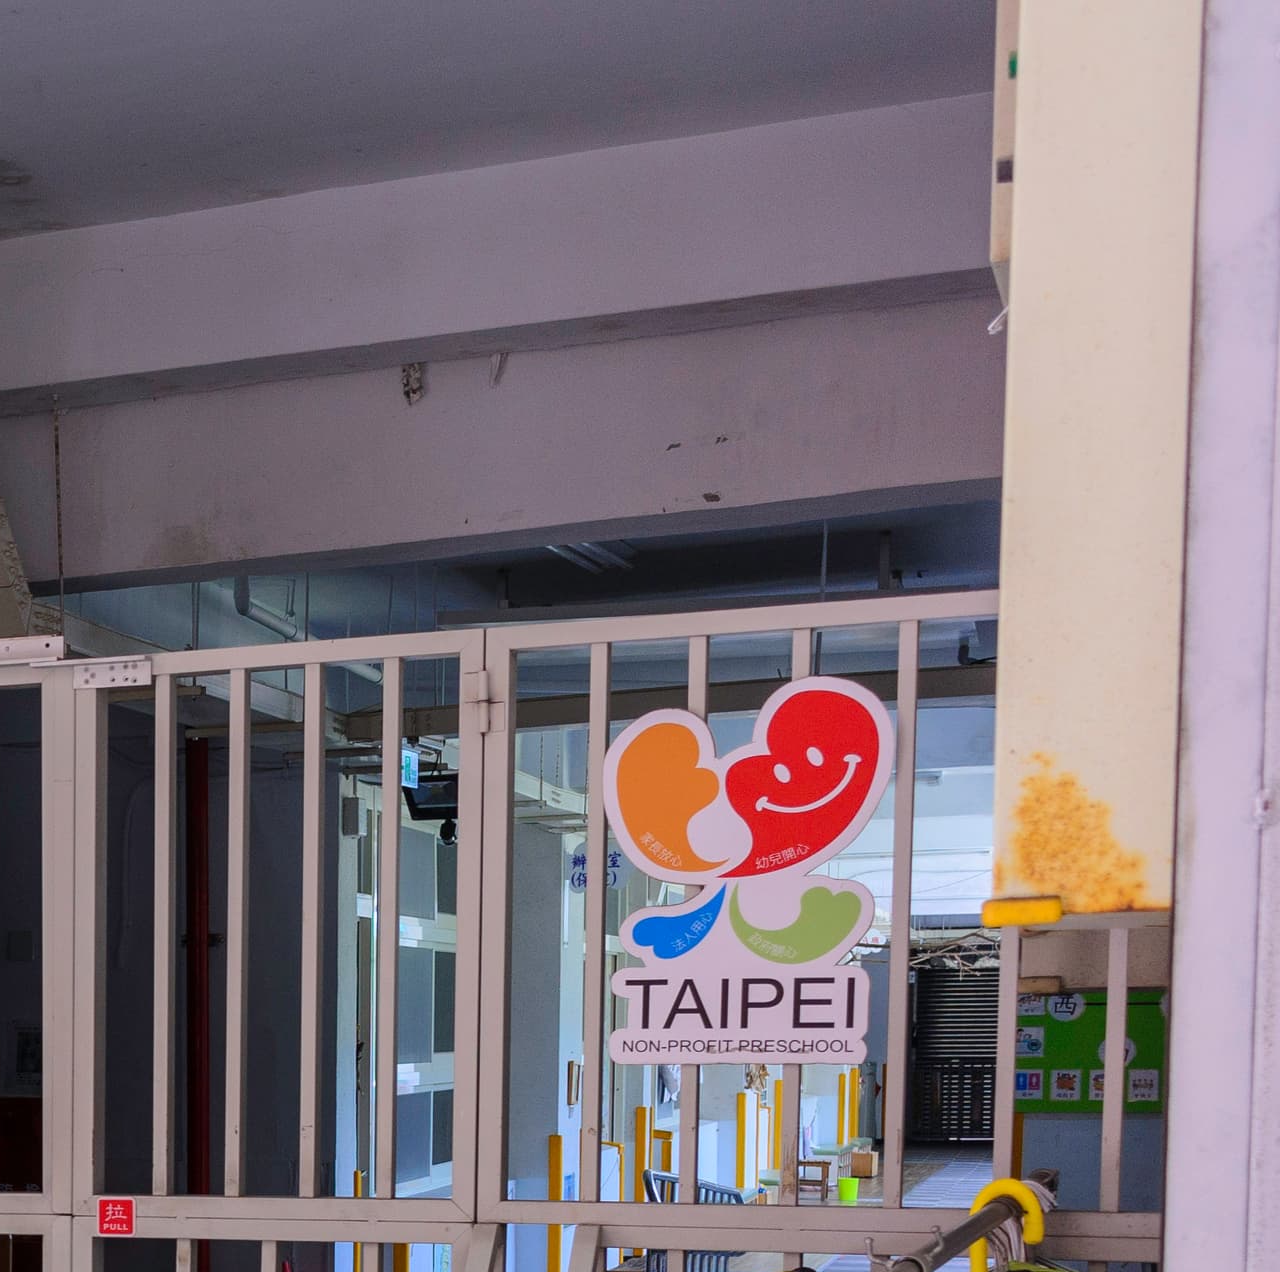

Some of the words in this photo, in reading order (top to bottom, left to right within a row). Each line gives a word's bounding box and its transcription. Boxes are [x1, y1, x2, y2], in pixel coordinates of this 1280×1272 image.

[571, 851, 621, 870] 辦室
[640, 831, 683, 868] 家長放心
[755, 844, 810, 870] 幼兒開心
[671, 912, 714, 953] 法人用心
[625, 976, 855, 1030] TAIPEI
[622, 1038, 734, 1054] NON-PROFIT
[739, 1038, 854, 1054] PRESCHOOL
[104, 1202, 128, 1221] 拉
[103, 1223, 129, 1231] PULL
